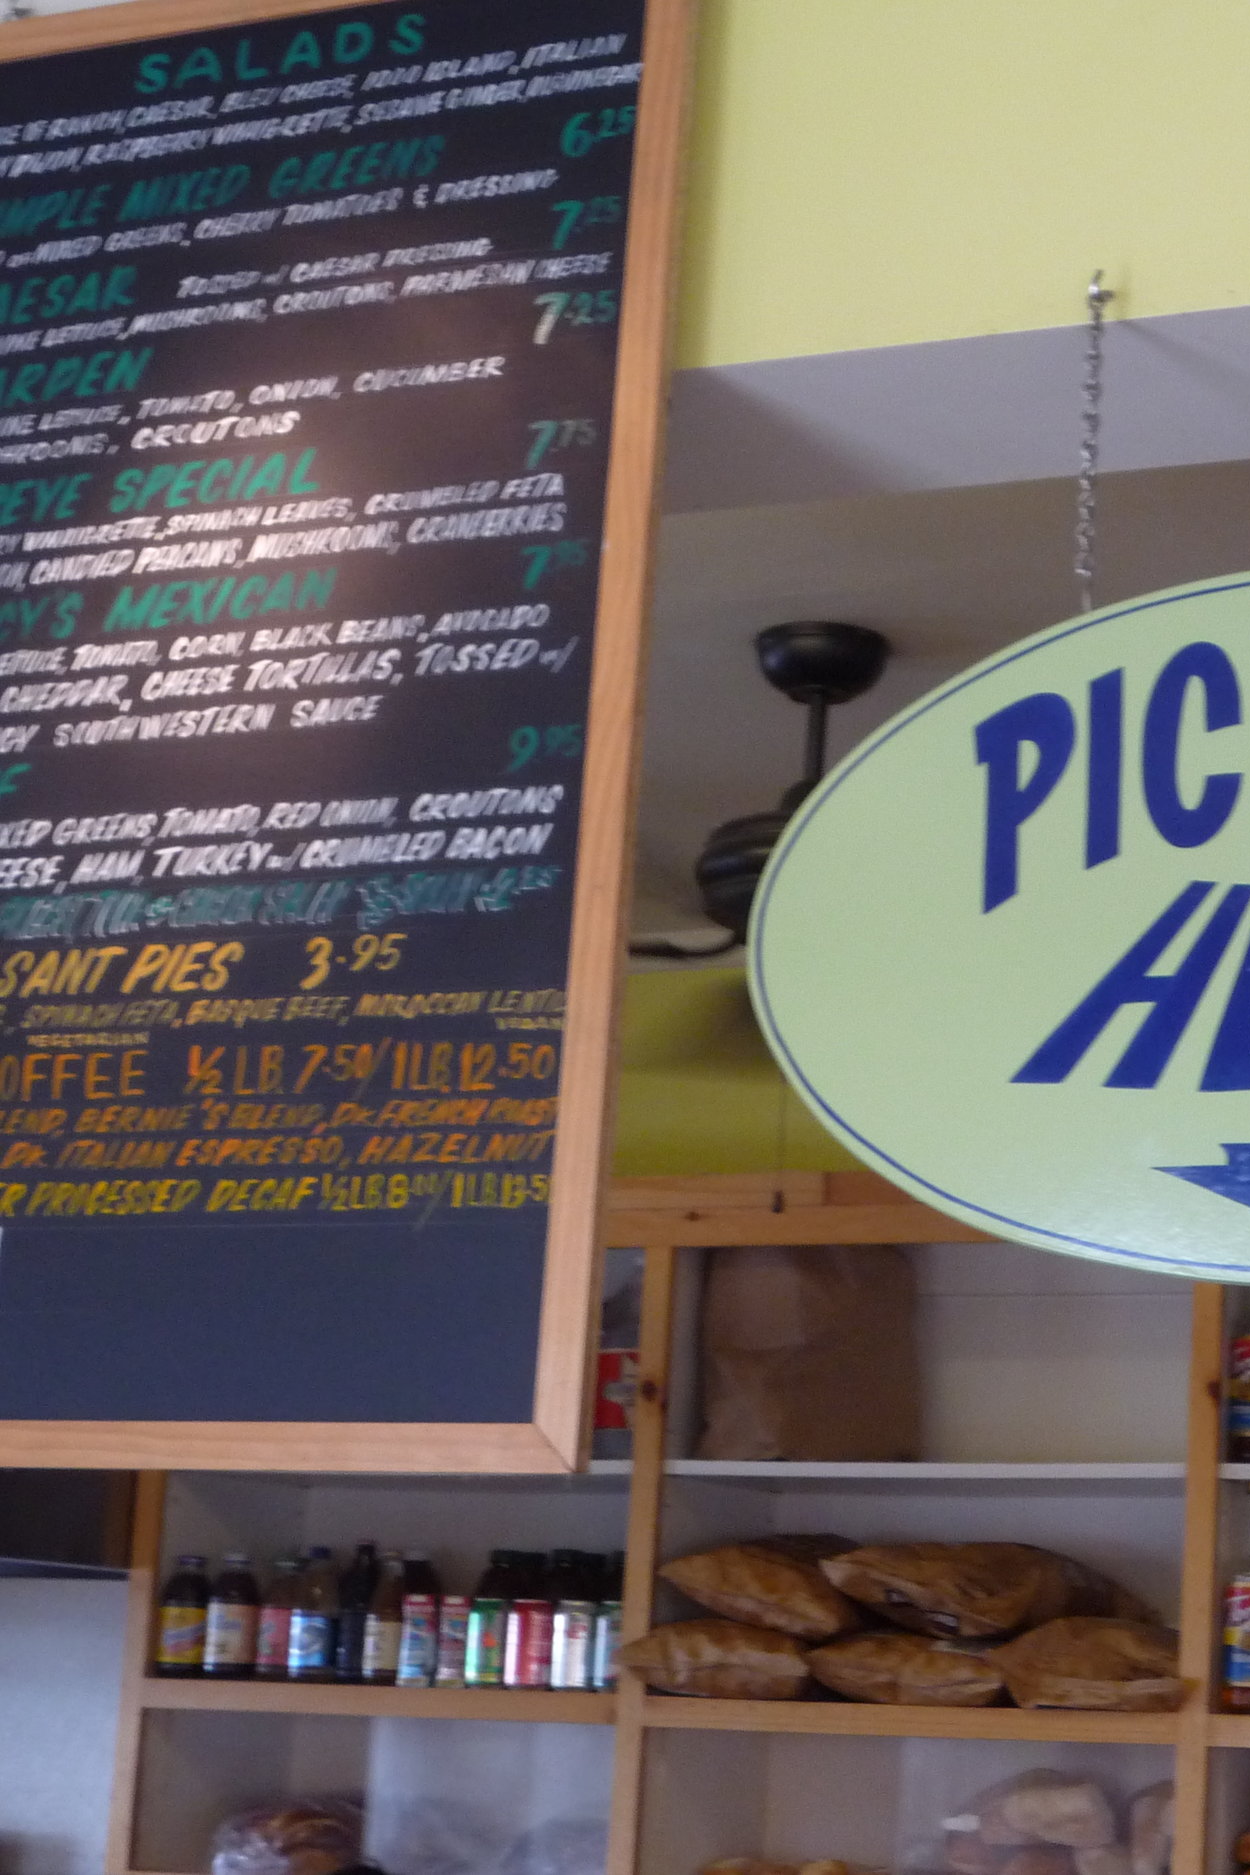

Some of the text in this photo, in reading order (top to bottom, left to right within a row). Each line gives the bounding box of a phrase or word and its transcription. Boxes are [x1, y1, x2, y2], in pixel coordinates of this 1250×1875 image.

[134, 13, 426, 94] SALADS
[118, 164, 250, 222] MIXED
[268, 135, 446, 199] GREENS
[289, 253, 381, 283] CAESAR
[0, 346, 154, 408] RDEN
[135, 389, 243, 420] TOMATO,
[353, 356, 505, 393] CUCUMBER
[131, 410, 300, 450] CROUTONS
[0, 448, 320, 526] EYE SPECIAL
[500, 472, 564, 500] FETA
[103, 567, 339, 632] MEXICAN
[250, 622, 334, 652] BLACK
[335, 614, 428, 645] BEANS,
[140, 664, 241, 701] CHEESE
[243, 649, 404, 692] TORTILLAS,
[413, 638, 541, 677] TOSSED
[289, 695, 385, 728] SAUCE
[262, 801, 321, 830] RED
[409, 784, 564, 822] CROUTONS
[152, 841, 274, 878] TURKEY
[444, 822, 554, 860] BACON
[0, 945, 129, 999] SANT
[118, 942, 245, 995] PIES
[0, 1050, 149, 1102] OFFEE
[174, 1134, 350, 1170] ESPRESSO,
[356, 1130, 558, 1166] HAZELNUT
[205, 1174, 319, 1213] DECAF
